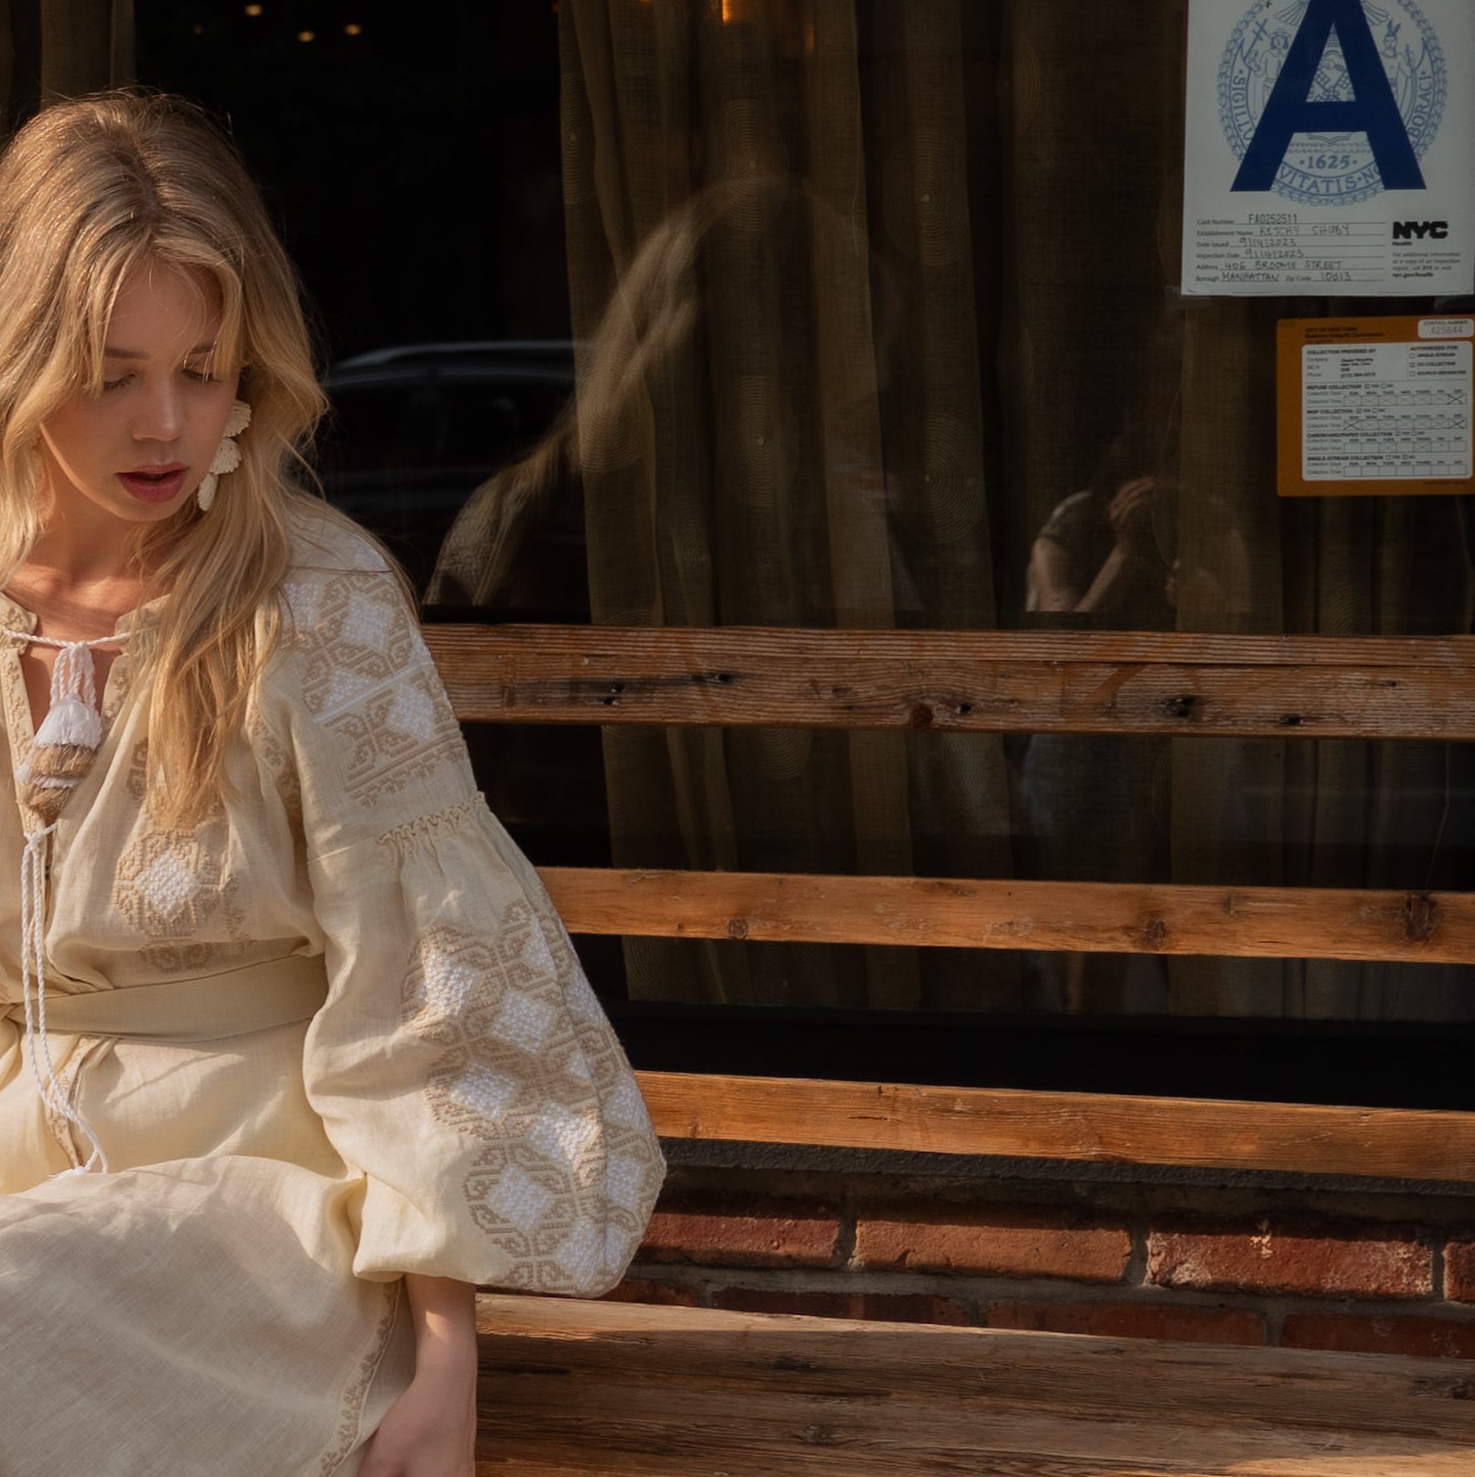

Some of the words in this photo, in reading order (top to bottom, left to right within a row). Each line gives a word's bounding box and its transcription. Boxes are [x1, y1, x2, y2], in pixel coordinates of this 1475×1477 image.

[1406, 73, 1432, 145] BORACI
[1307, 155, 1351, 170] 1625
[1393, 221, 1448, 239] NYC
[1305, 260, 1342, 270] STREET
[1222, 272, 1280, 282] MANHATTAN
